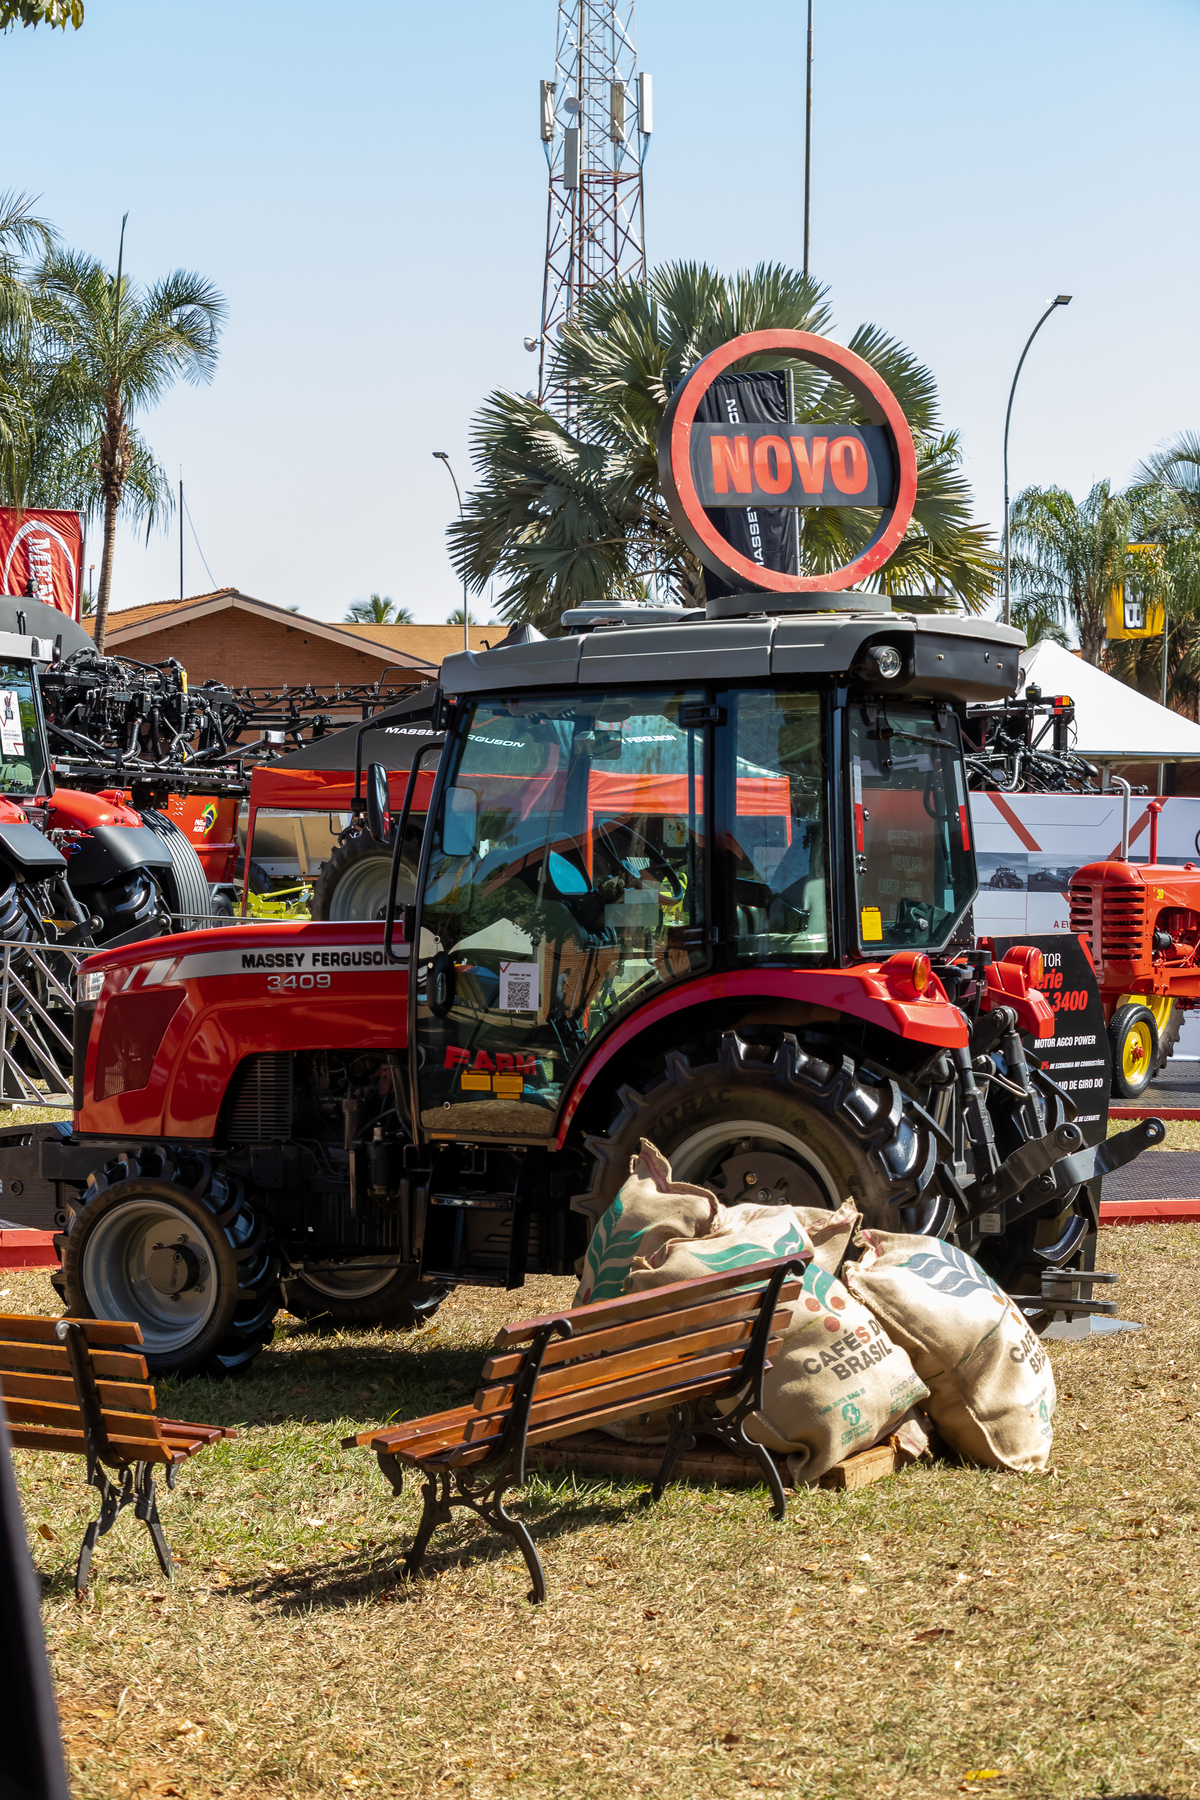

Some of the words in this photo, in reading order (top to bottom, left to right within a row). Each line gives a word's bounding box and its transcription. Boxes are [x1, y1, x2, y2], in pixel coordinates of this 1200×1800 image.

[710, 435, 869, 495] NOVO
[27, 536, 54, 608] MEN
[384, 726, 446, 737] MASSEY
[241, 952, 306, 968] MASSEY
[266, 974, 332, 991] 3409
[1052, 990, 1089, 1012] 3400
[1034, 1038, 1056, 1049] MOTOR
[1056, 1037, 1073, 1047] AGCO
[1074, 1034, 1097, 1046] POWER
[443, 1044, 538, 1075] FARM
[1055, 1080, 1069, 1090] AIO
[1069, 1080, 1078, 1090] DE
[1078, 1078, 1093, 1089] GIRO
[1094, 1078, 1104, 1088] DO
[803, 1326, 872, 1375] CAFÉS
[831, 1338, 893, 1381] BRASIL
[890, 1380, 909, 1398] FOOD
